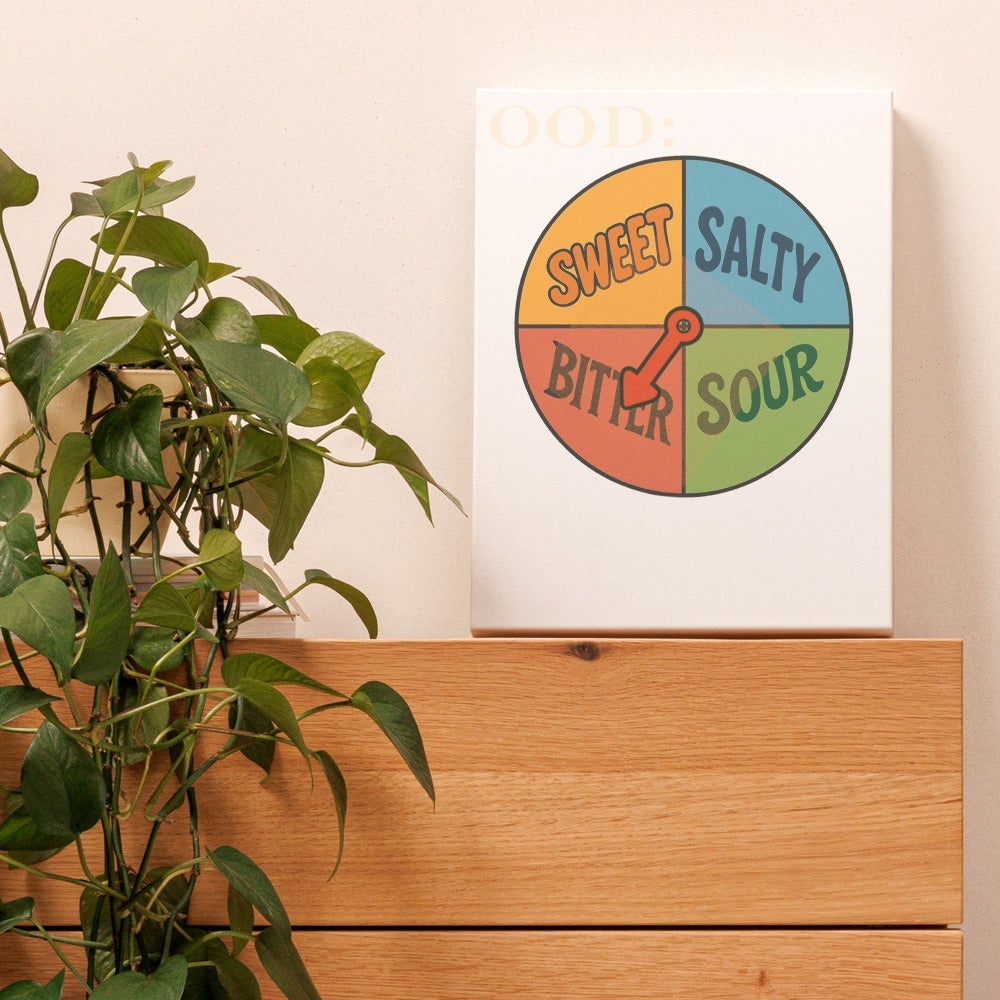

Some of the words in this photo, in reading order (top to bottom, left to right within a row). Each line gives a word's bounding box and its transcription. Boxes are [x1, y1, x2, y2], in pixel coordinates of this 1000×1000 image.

[476, 104, 675, 149] OOD:
[546, 203, 673, 307] SWEET
[695, 206, 821, 303] SALTY
[697, 343, 824, 435] SOUR
